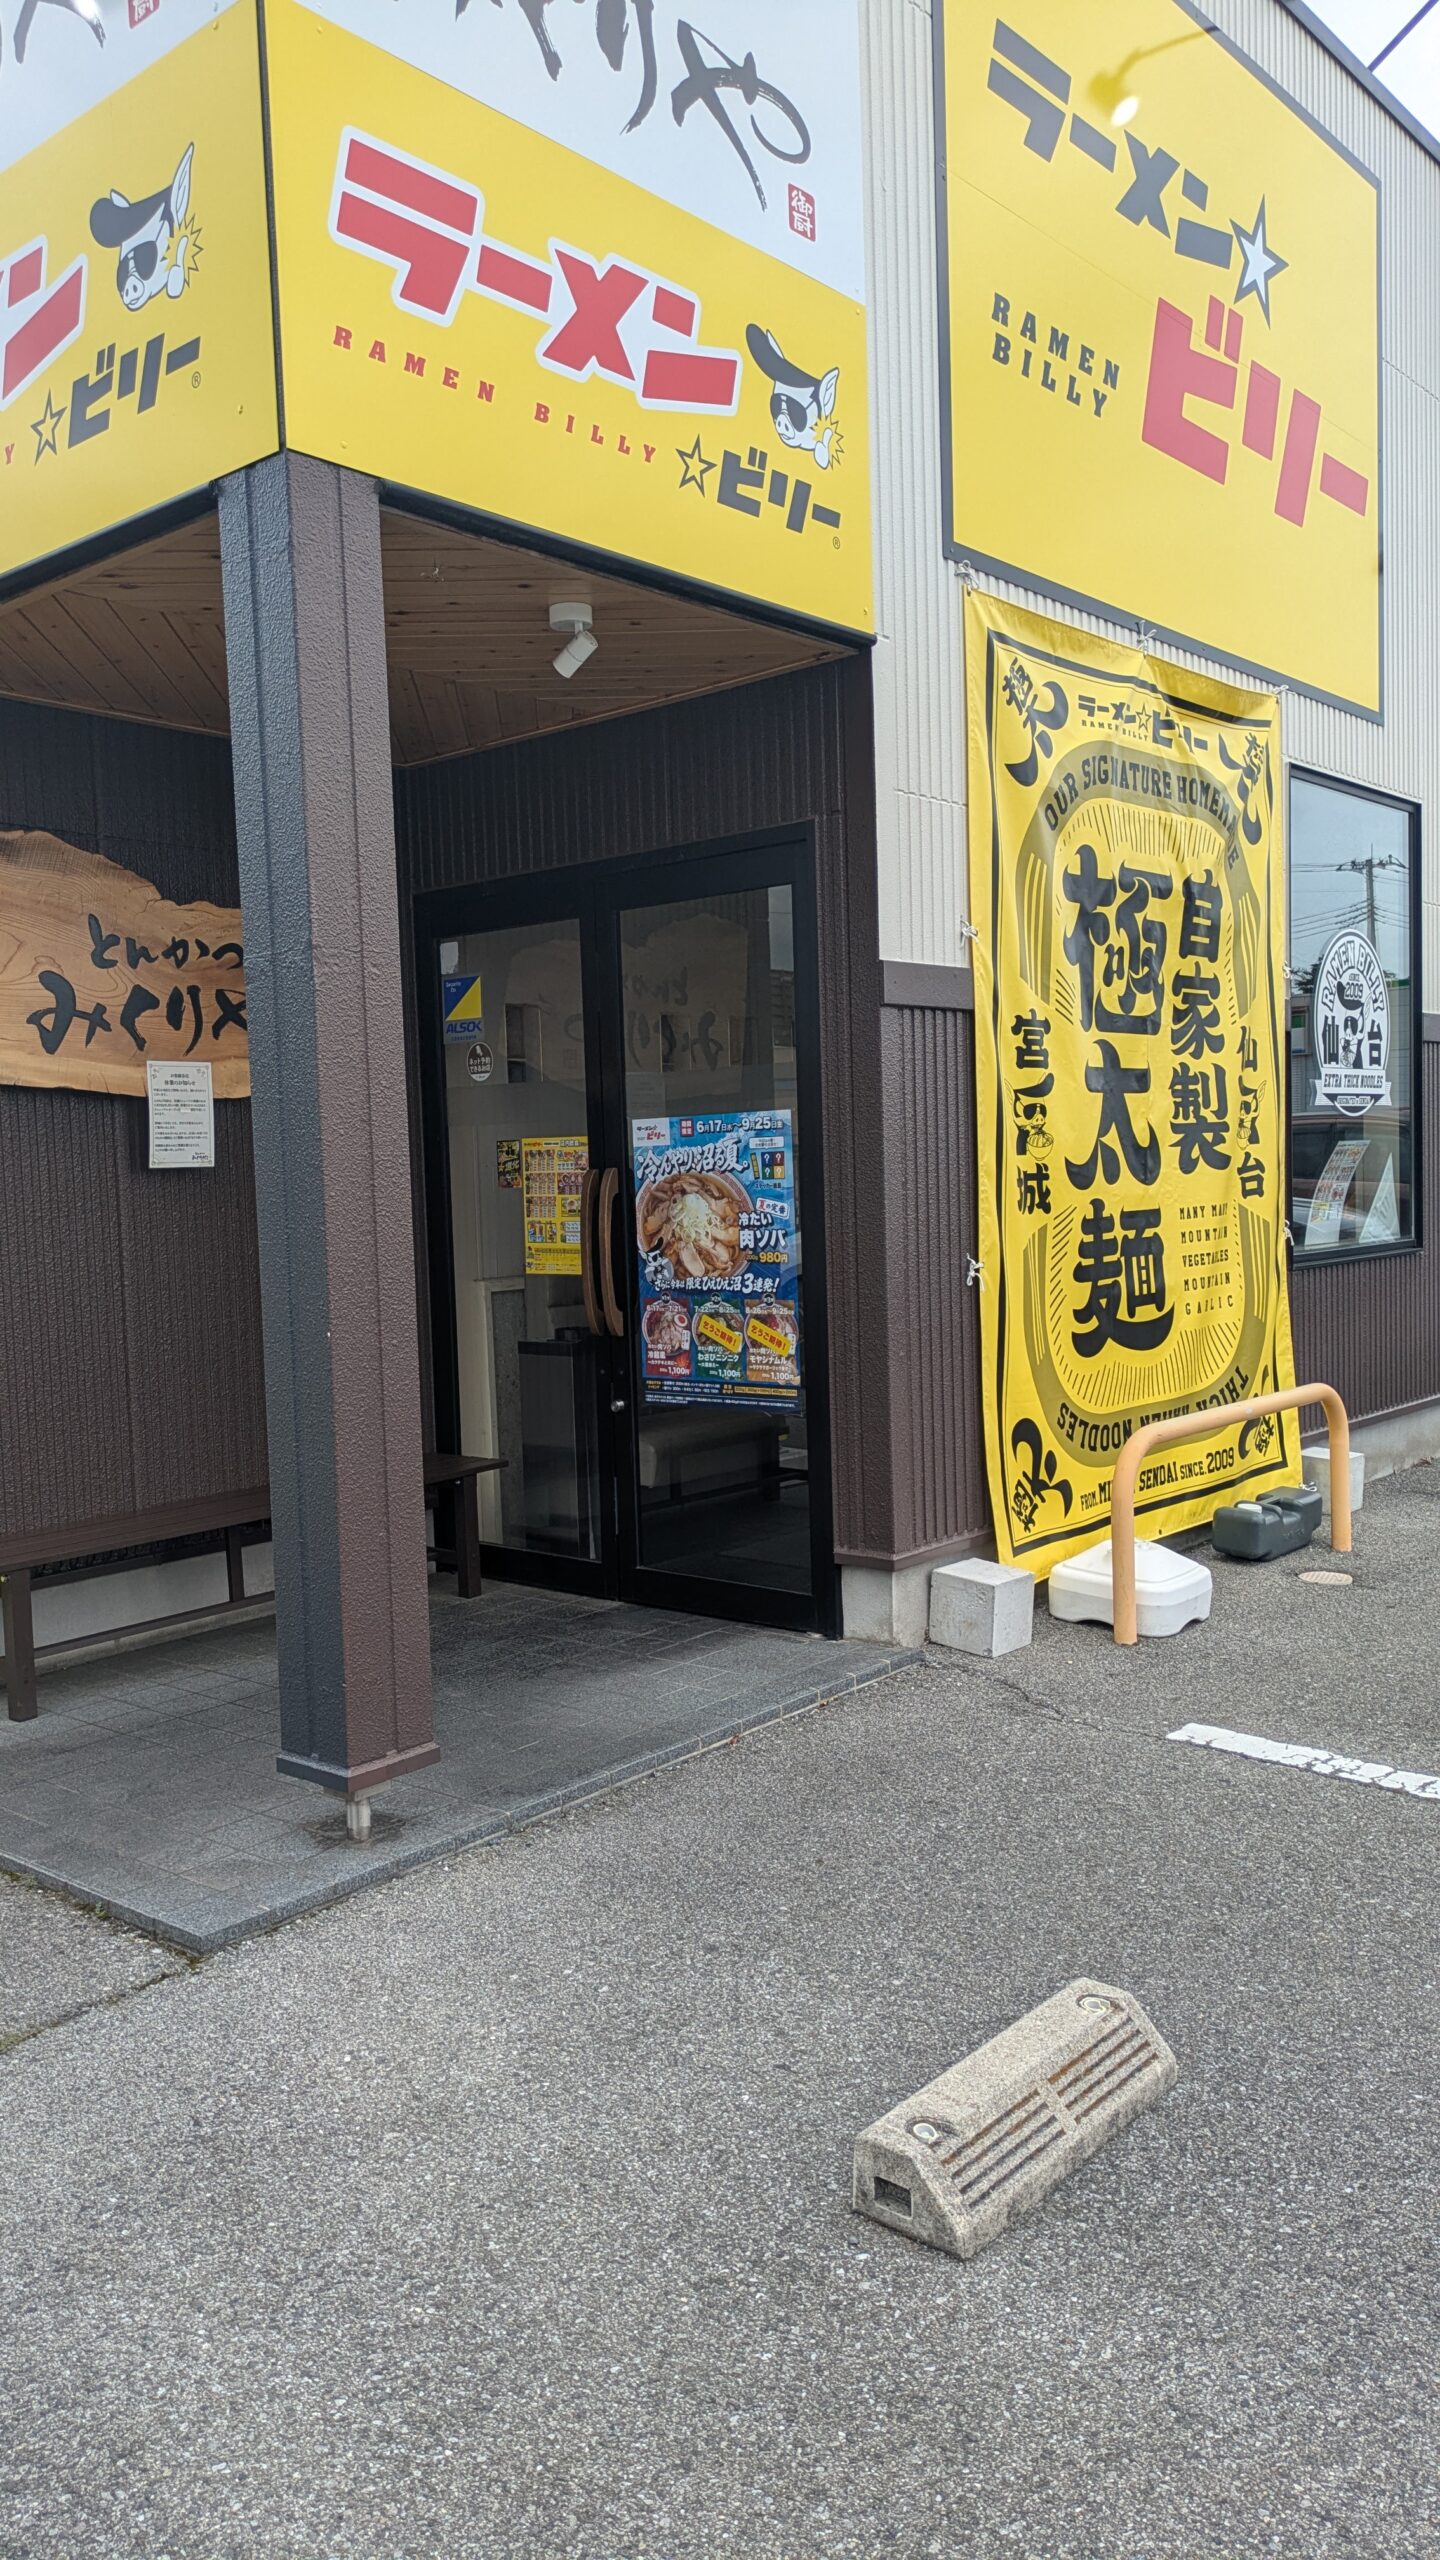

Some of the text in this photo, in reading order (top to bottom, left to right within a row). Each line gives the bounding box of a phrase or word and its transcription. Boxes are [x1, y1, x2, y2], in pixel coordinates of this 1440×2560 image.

[987, 18, 1233, 270] ラーメン
[336, 137, 738, 407] ラーメン
[992, 292, 1120, 390] RAMEN
[992, 332, 1109, 418] BILLY
[68, 333, 201, 449] ビリー
[333, 325, 657, 464] RAMEN BILLY
[1141, 295, 1369, 528] ビリー
[716, 446, 841, 534] ビリー
[1078, 694, 1137, 724] ラーメン
[1122, 726, 1148, 741] BILLY
[1044, 772, 1079, 831] OUR
[1081, 754, 1173, 801] SIGNATURE
[88, 914, 244, 969] とんかつ
[1322, 940, 1385, 1013] RAMEN BILLY
[1169, 867, 1232, 1174] 自家製
[1344, 982, 1364, 999] 2009
[1061, 844, 1176, 1358] 極太麺
[1324, 1073, 1342, 1088] EXTRA
[738, 1211, 772, 1227] 冷たい
[739, 1228, 787, 1249] 肉ソバ
[1180, 1205, 1205, 1220] MANY
[759, 1251, 788, 1263] 980円
[1056, 1402, 1133, 1452] NOODLES
[1139, 1461, 1178, 1491] SENDAI
[1206, 1447, 1235, 1473] 2009
